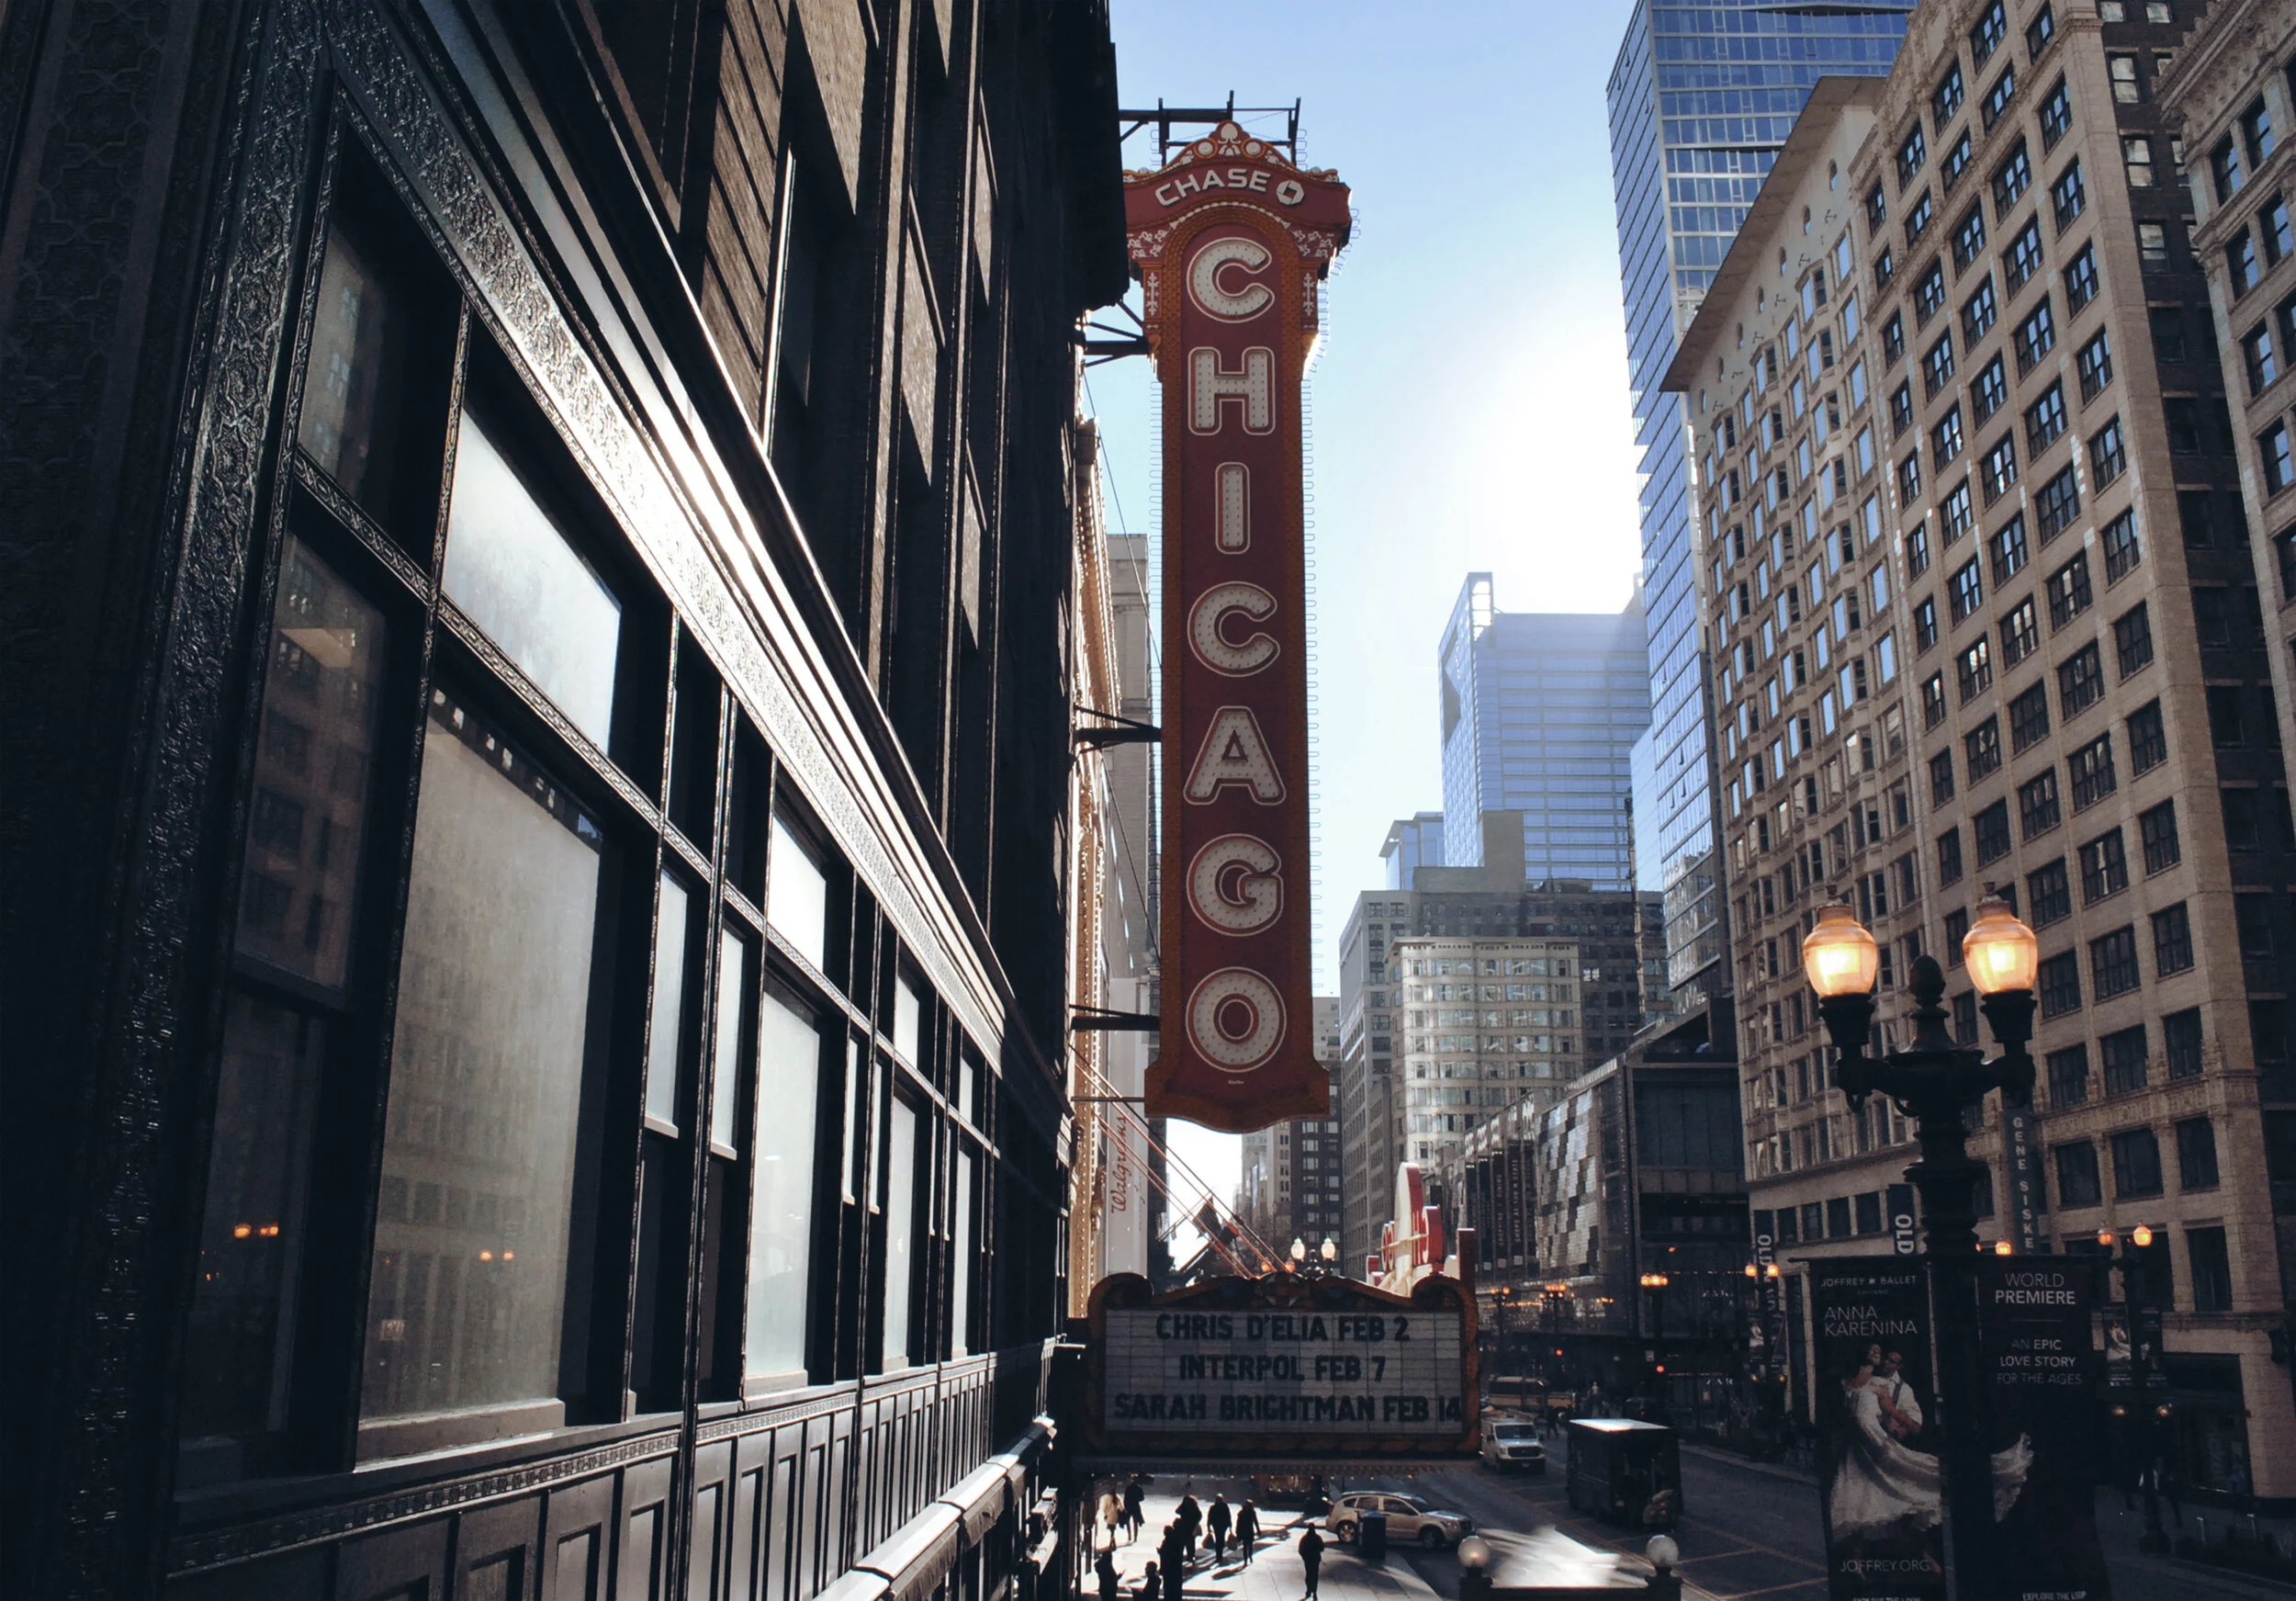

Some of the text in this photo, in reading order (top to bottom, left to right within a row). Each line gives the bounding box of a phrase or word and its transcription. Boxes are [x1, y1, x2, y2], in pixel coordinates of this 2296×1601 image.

[1154, 169, 1272, 207] CHASE
[1184, 237, 1287, 1073] CHICAGO
[2013, 1117, 2034, 1254] GENE SISKE
[1895, 1214, 1915, 1254] OLD
[1757, 1235, 1773, 1267] OLD
[1820, 1275, 1918, 1288] JOFFREY BALLET
[2005, 1272, 2065, 1288] WORLD
[1995, 1289, 2077, 1304] PREMIERE
[1823, 1305, 1878, 1321] ANNA
[1155, 1314, 1411, 1341] CHRIS D'ELIA FEB 2
[1824, 1319, 1919, 1337] KARENINA
[2010, 1338, 2063, 1350] AN EPIC
[1179, 1354, 1387, 1381] INTERPOL FEB 7
[1999, 1355, 2077, 1368] LOVE STORY
[1997, 1372, 2083, 1385] FOR THE AGES
[1114, 1393, 1462, 1423] SARAH BRIGHTMAN FEB 14
[1840, 1560, 1930, 1573] JOFFREY.ORG
